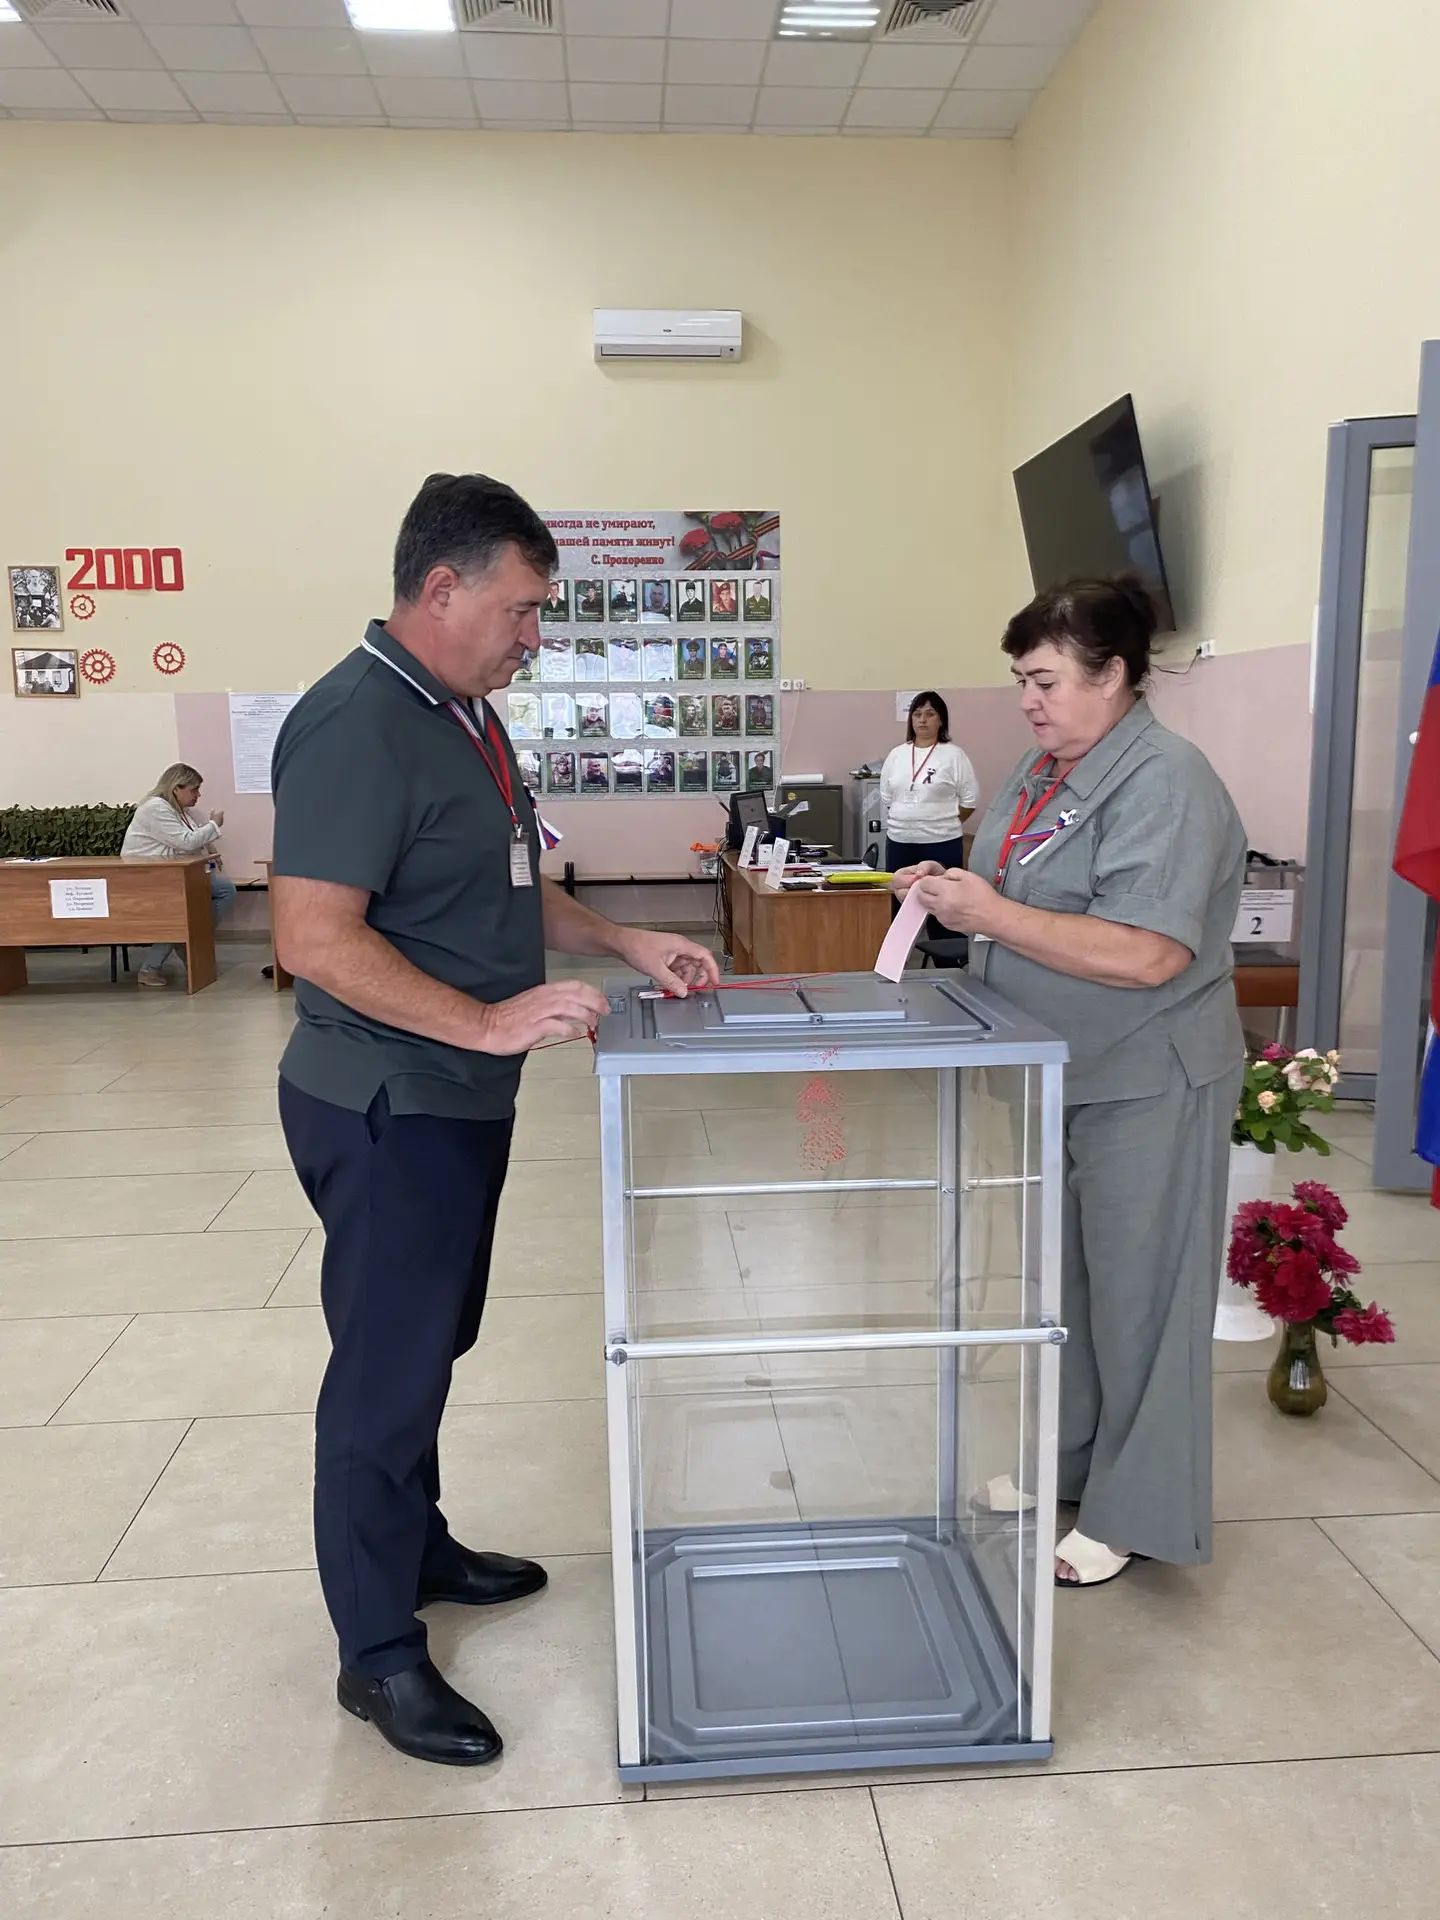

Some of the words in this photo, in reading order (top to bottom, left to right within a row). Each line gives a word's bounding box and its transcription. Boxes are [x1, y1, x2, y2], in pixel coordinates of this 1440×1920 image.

[543, 519, 583, 529] икогда
[585, 519, 600, 528] не
[601, 519, 656, 530] умирают,
[591, 539, 634, 547] памяти
[635, 536, 675, 549] живут!
[590, 554, 601, 565] С.
[602, 554, 665, 567] Прохоренко
[65, 548, 184, 591] 2000
[1249, 916, 1262, 935] 2
